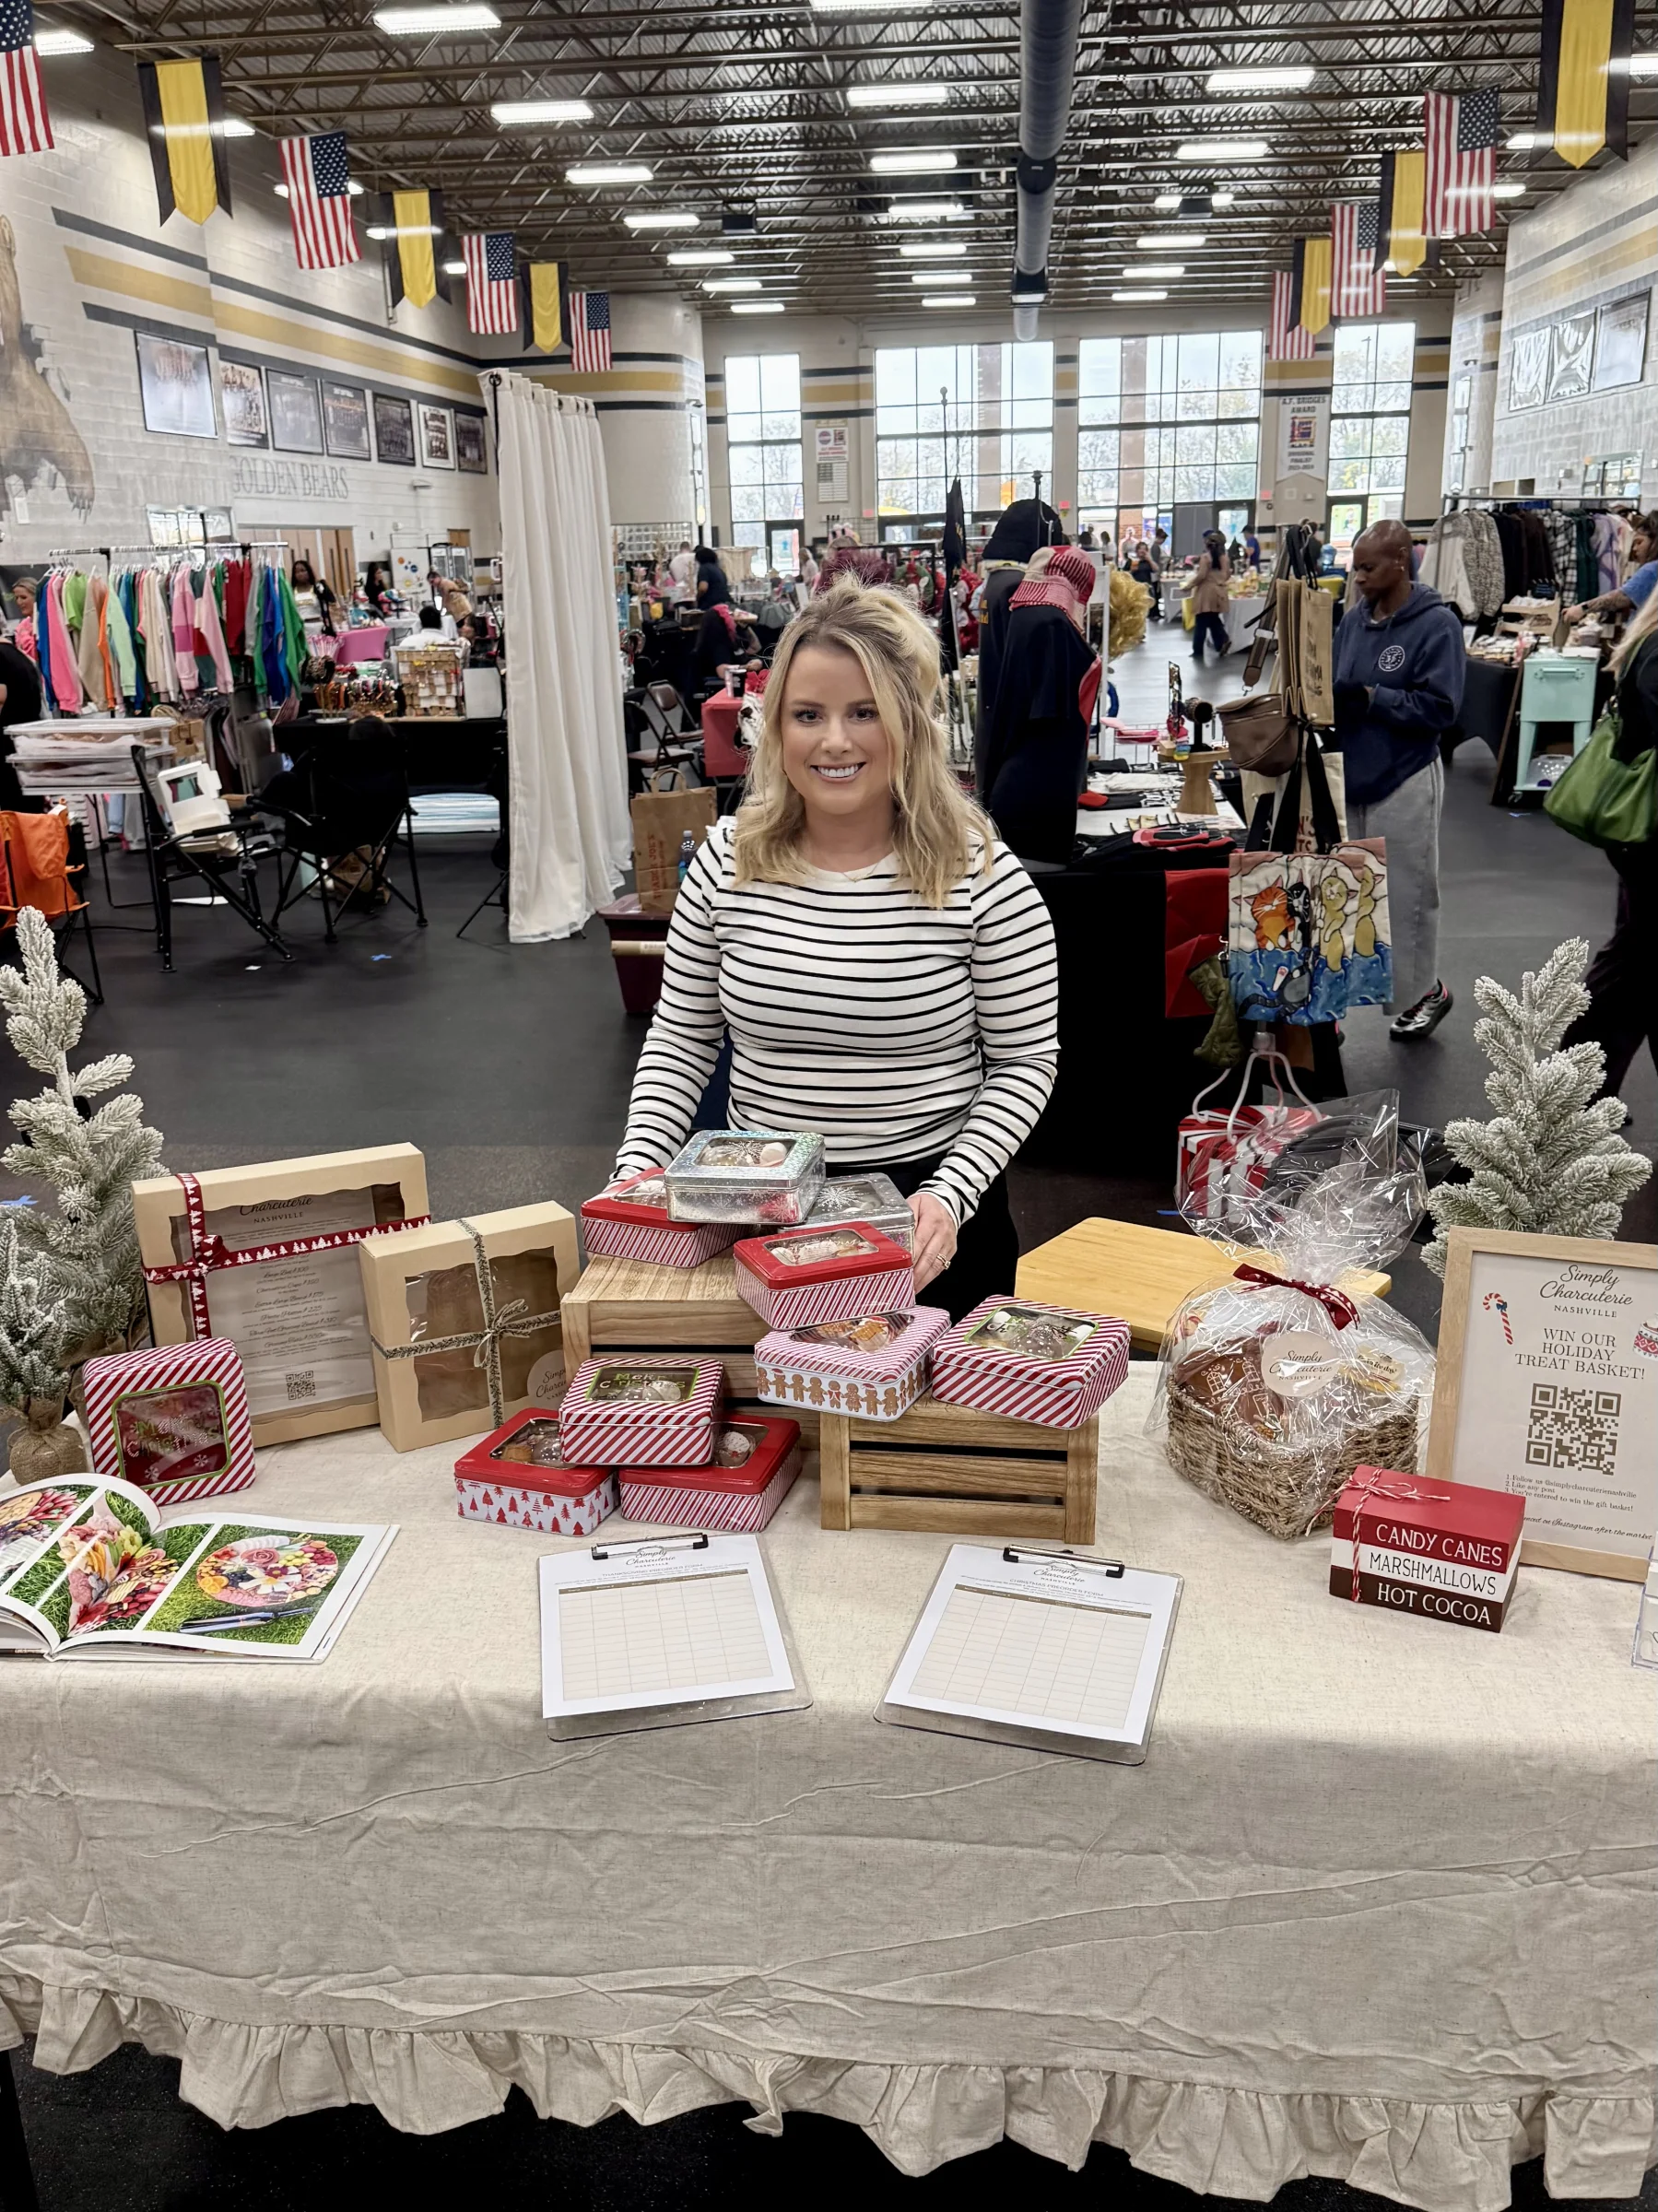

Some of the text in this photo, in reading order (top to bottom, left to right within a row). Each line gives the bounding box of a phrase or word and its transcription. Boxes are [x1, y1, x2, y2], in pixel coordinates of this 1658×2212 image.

[300, 463, 349, 500] BEARS
[253, 1212, 303, 1224] NASHVILLE
[1560, 1265, 1620, 1290] Simply
[1539, 1281, 1633, 1305] Charcuterie
[1554, 1305, 1617, 1318] NASHVILLE
[1544, 1327, 1617, 1347] WIN OUR
[1284, 1351, 1323, 1363] Simply
[1543, 1342, 1615, 1361] HOLIDAY
[1515, 1353, 1646, 1381] TREAT BASKET!
[542, 1370, 566, 1384] Simp
[1511, 1481, 1526, 1489] Like
[1512, 1475, 1533, 1484] Follow
[1545, 1478, 1637, 1499] @simplycharcuterienashville
[1534, 1491, 1558, 1501] entered
[1596, 1500, 1607, 1509] gift
[1609, 1502, 1633, 1512] basket!
[1552, 1517, 1593, 1532] Instagram
[1594, 1526, 1612, 1535] after
[1613, 1528, 1625, 1536] the
[1626, 1532, 1652, 1541] market
[636, 1549, 668, 1560] Simply
[1376, 1524, 1502, 1567] CANDY CANES
[626, 1556, 676, 1566] Charcuterie
[1033, 1569, 1086, 1583] Charcuterie
[1045, 1565, 1078, 1577] Simply
[1370, 1552, 1497, 1595] MARSHMALLOWS
[1010, 1578, 1046, 1587] CHRISTMAS
[1377, 1583, 1491, 1626] HOT COCOA
